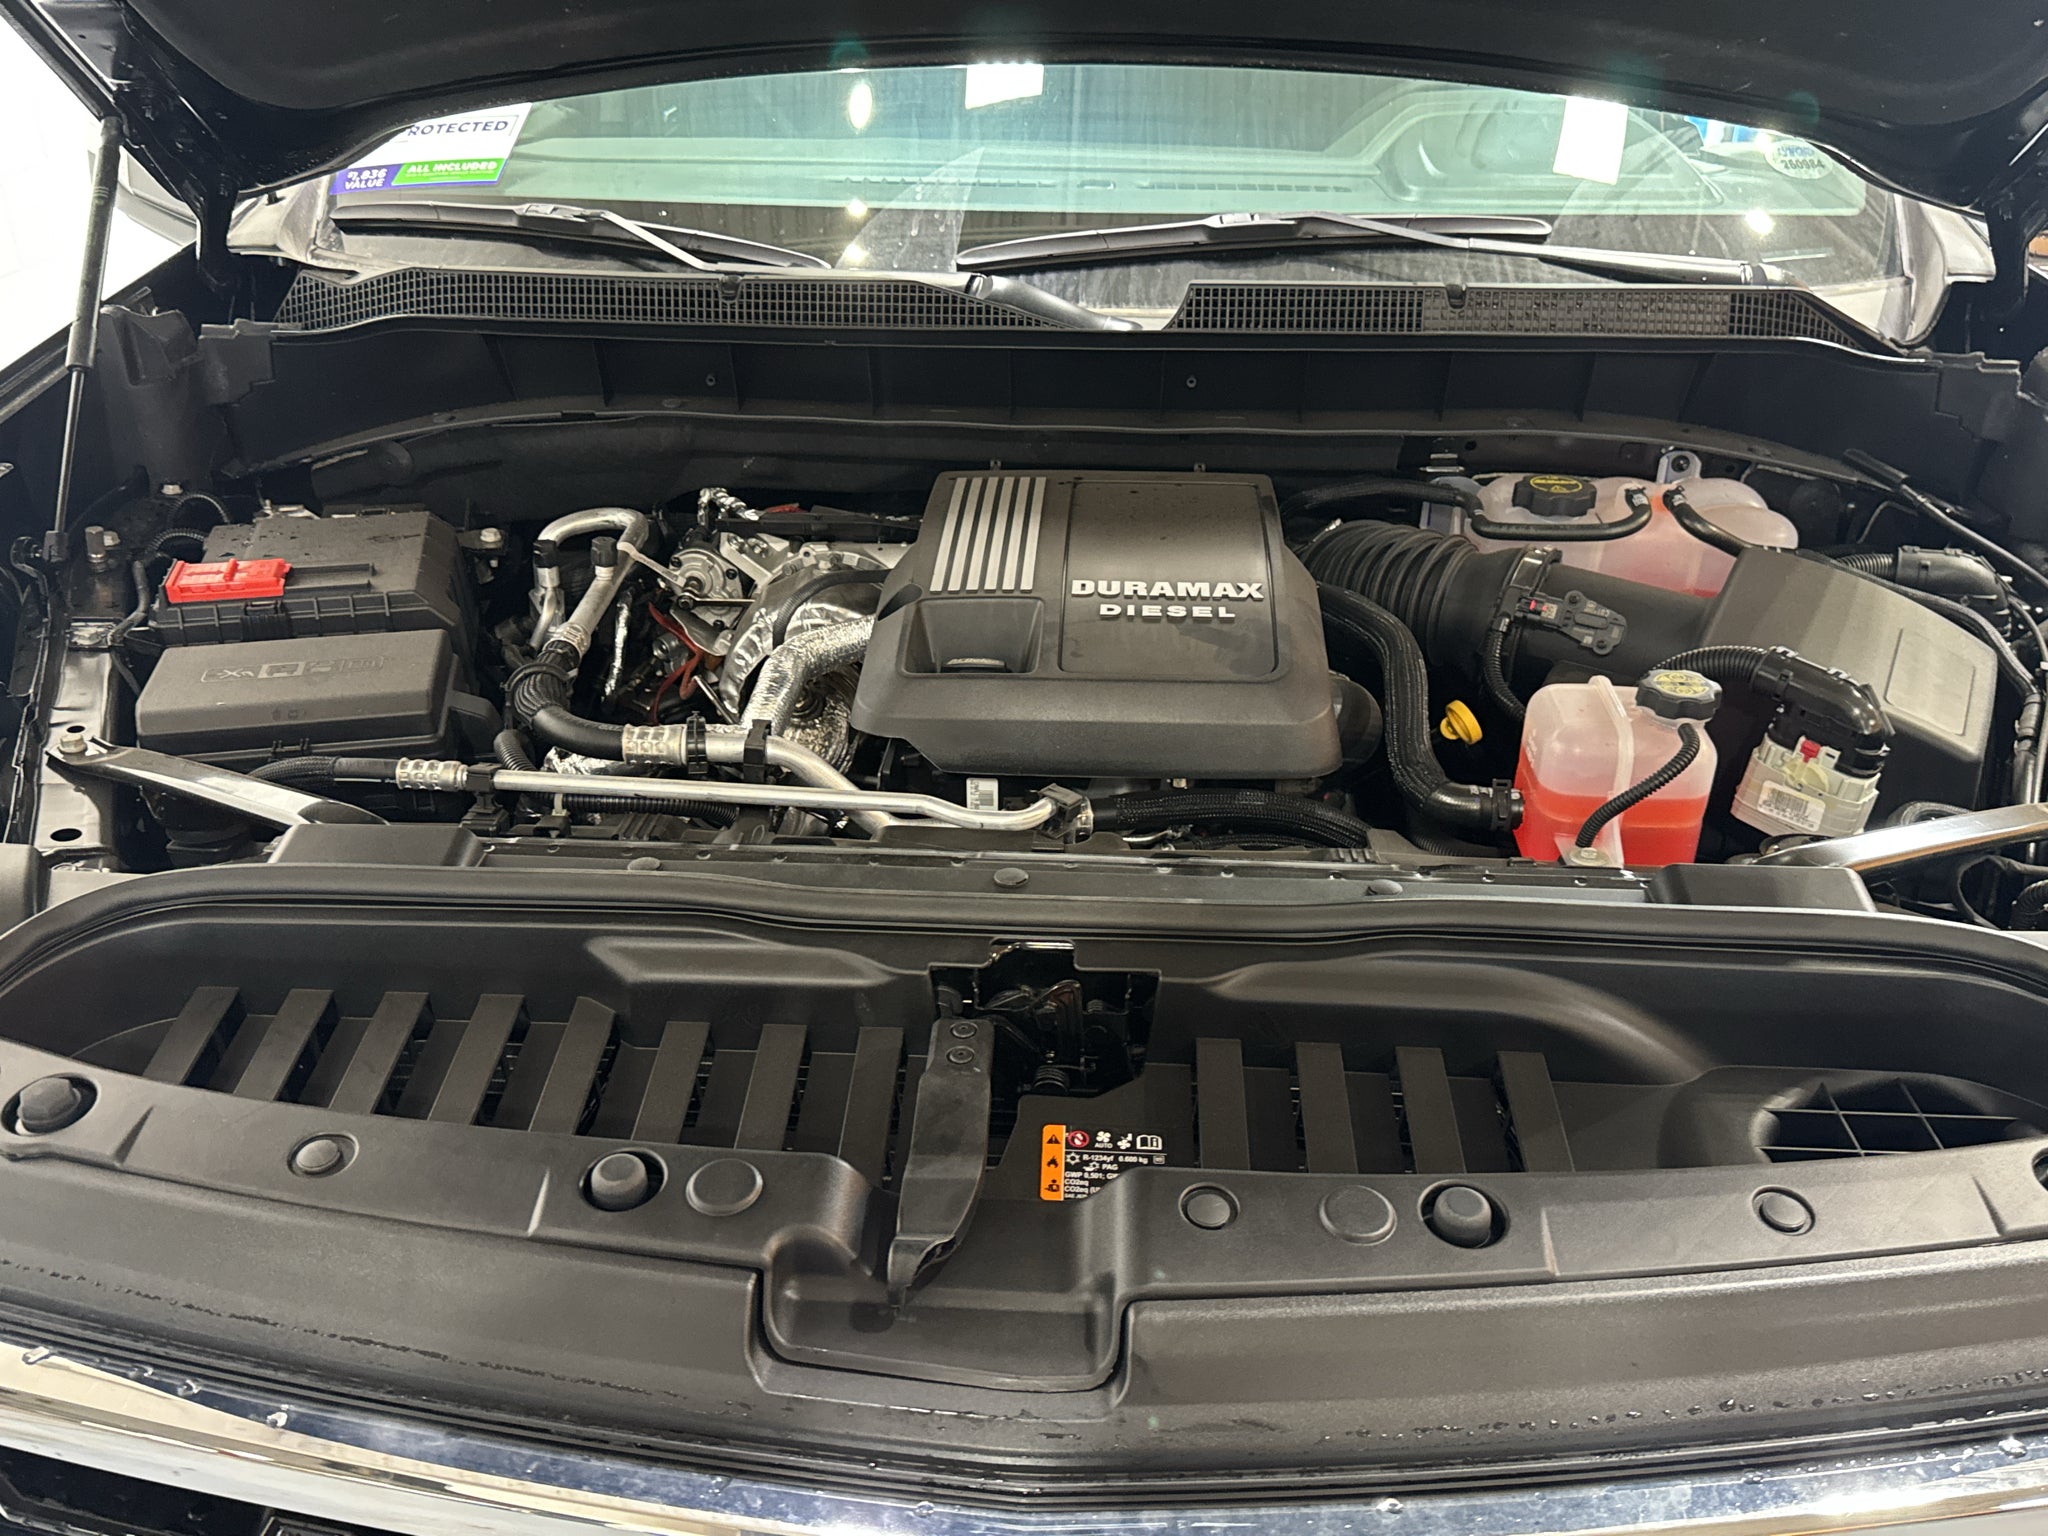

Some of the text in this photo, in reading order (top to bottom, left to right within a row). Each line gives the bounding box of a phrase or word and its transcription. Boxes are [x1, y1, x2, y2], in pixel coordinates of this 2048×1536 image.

[405, 120, 509, 137] ROTECTED
[406, 160, 498, 174] ALL INCLUDED
[344, 178, 386, 190] VALUE
[1071, 579, 1264, 600] DURAMAX
[1099, 603, 1236, 619] DIESEL
[1102, 1163, 1118, 1171] PAG
